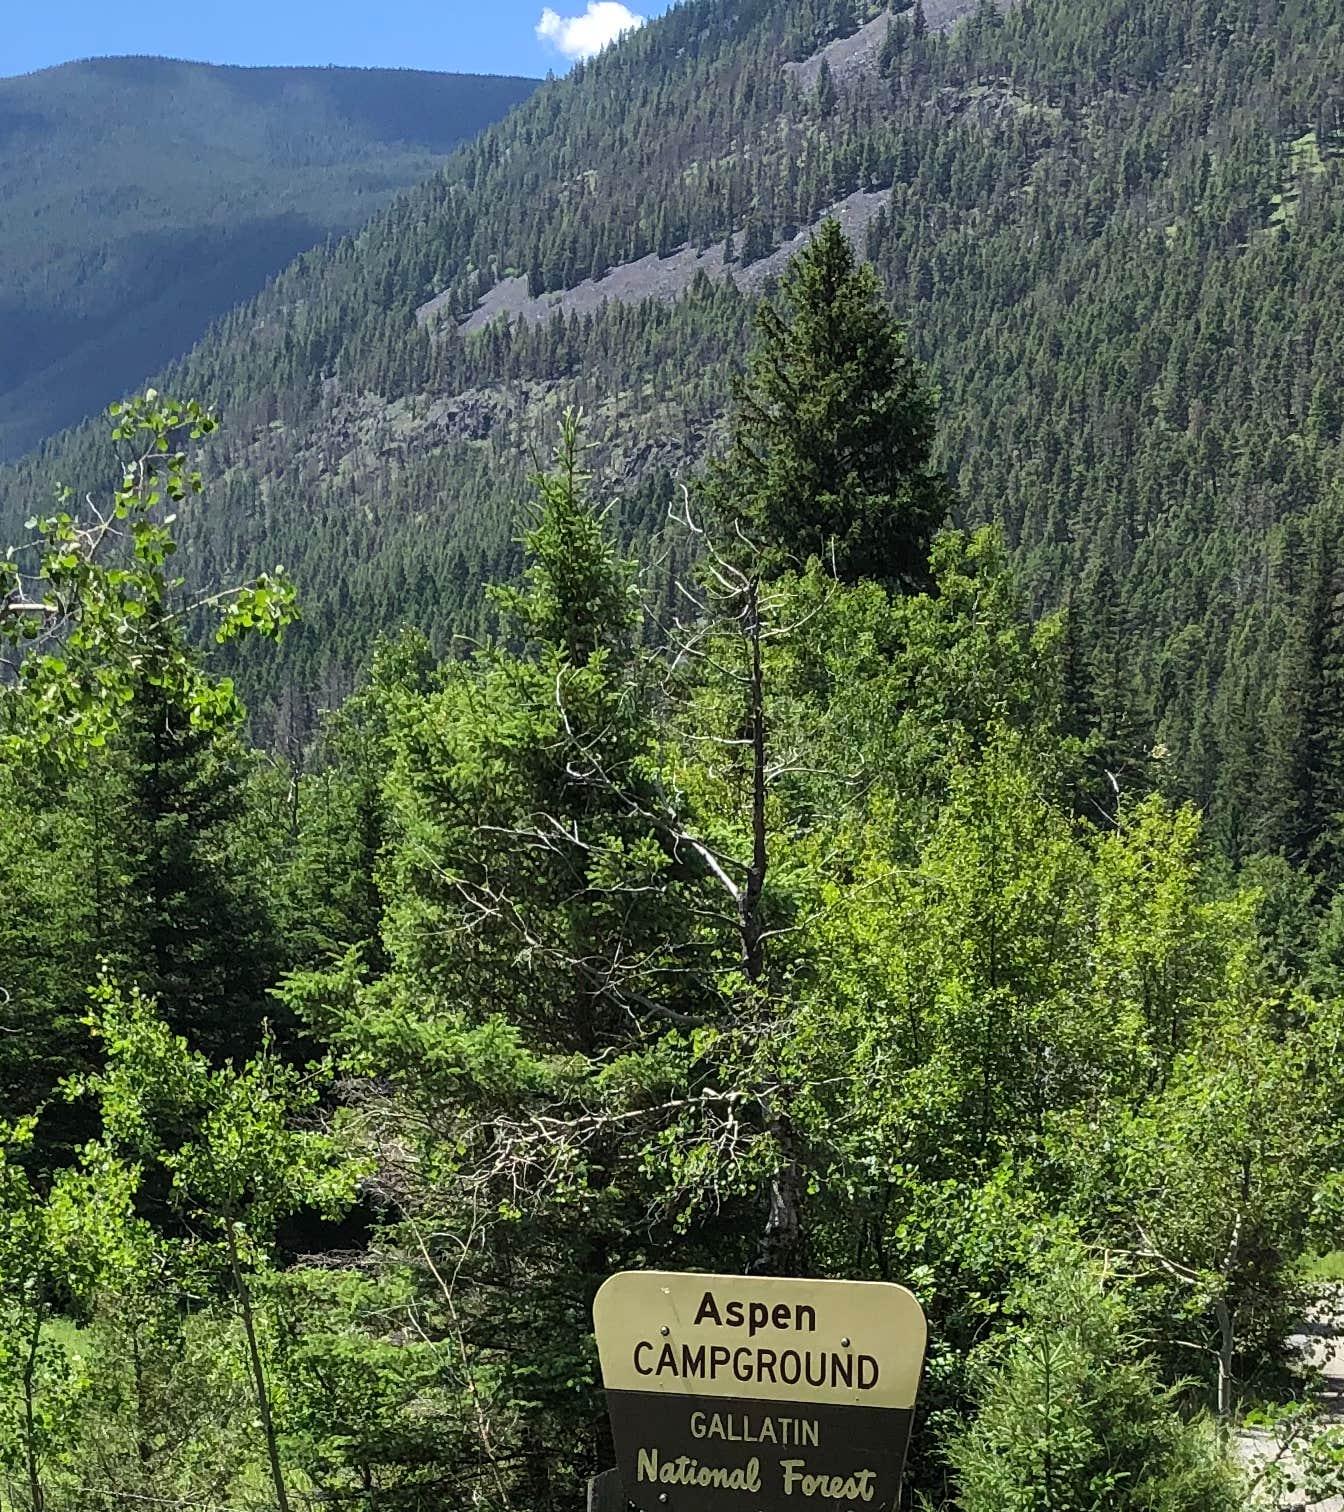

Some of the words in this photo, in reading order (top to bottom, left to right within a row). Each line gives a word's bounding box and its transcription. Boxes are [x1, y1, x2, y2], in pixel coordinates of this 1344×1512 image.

[694, 1292, 816, 1337] Aspen
[634, 1341, 879, 1390] CAMPGROUND
[691, 1411, 819, 1447] GALLATIN
[637, 1448, 761, 1493] National
[780, 1460, 876, 1502] Forest
